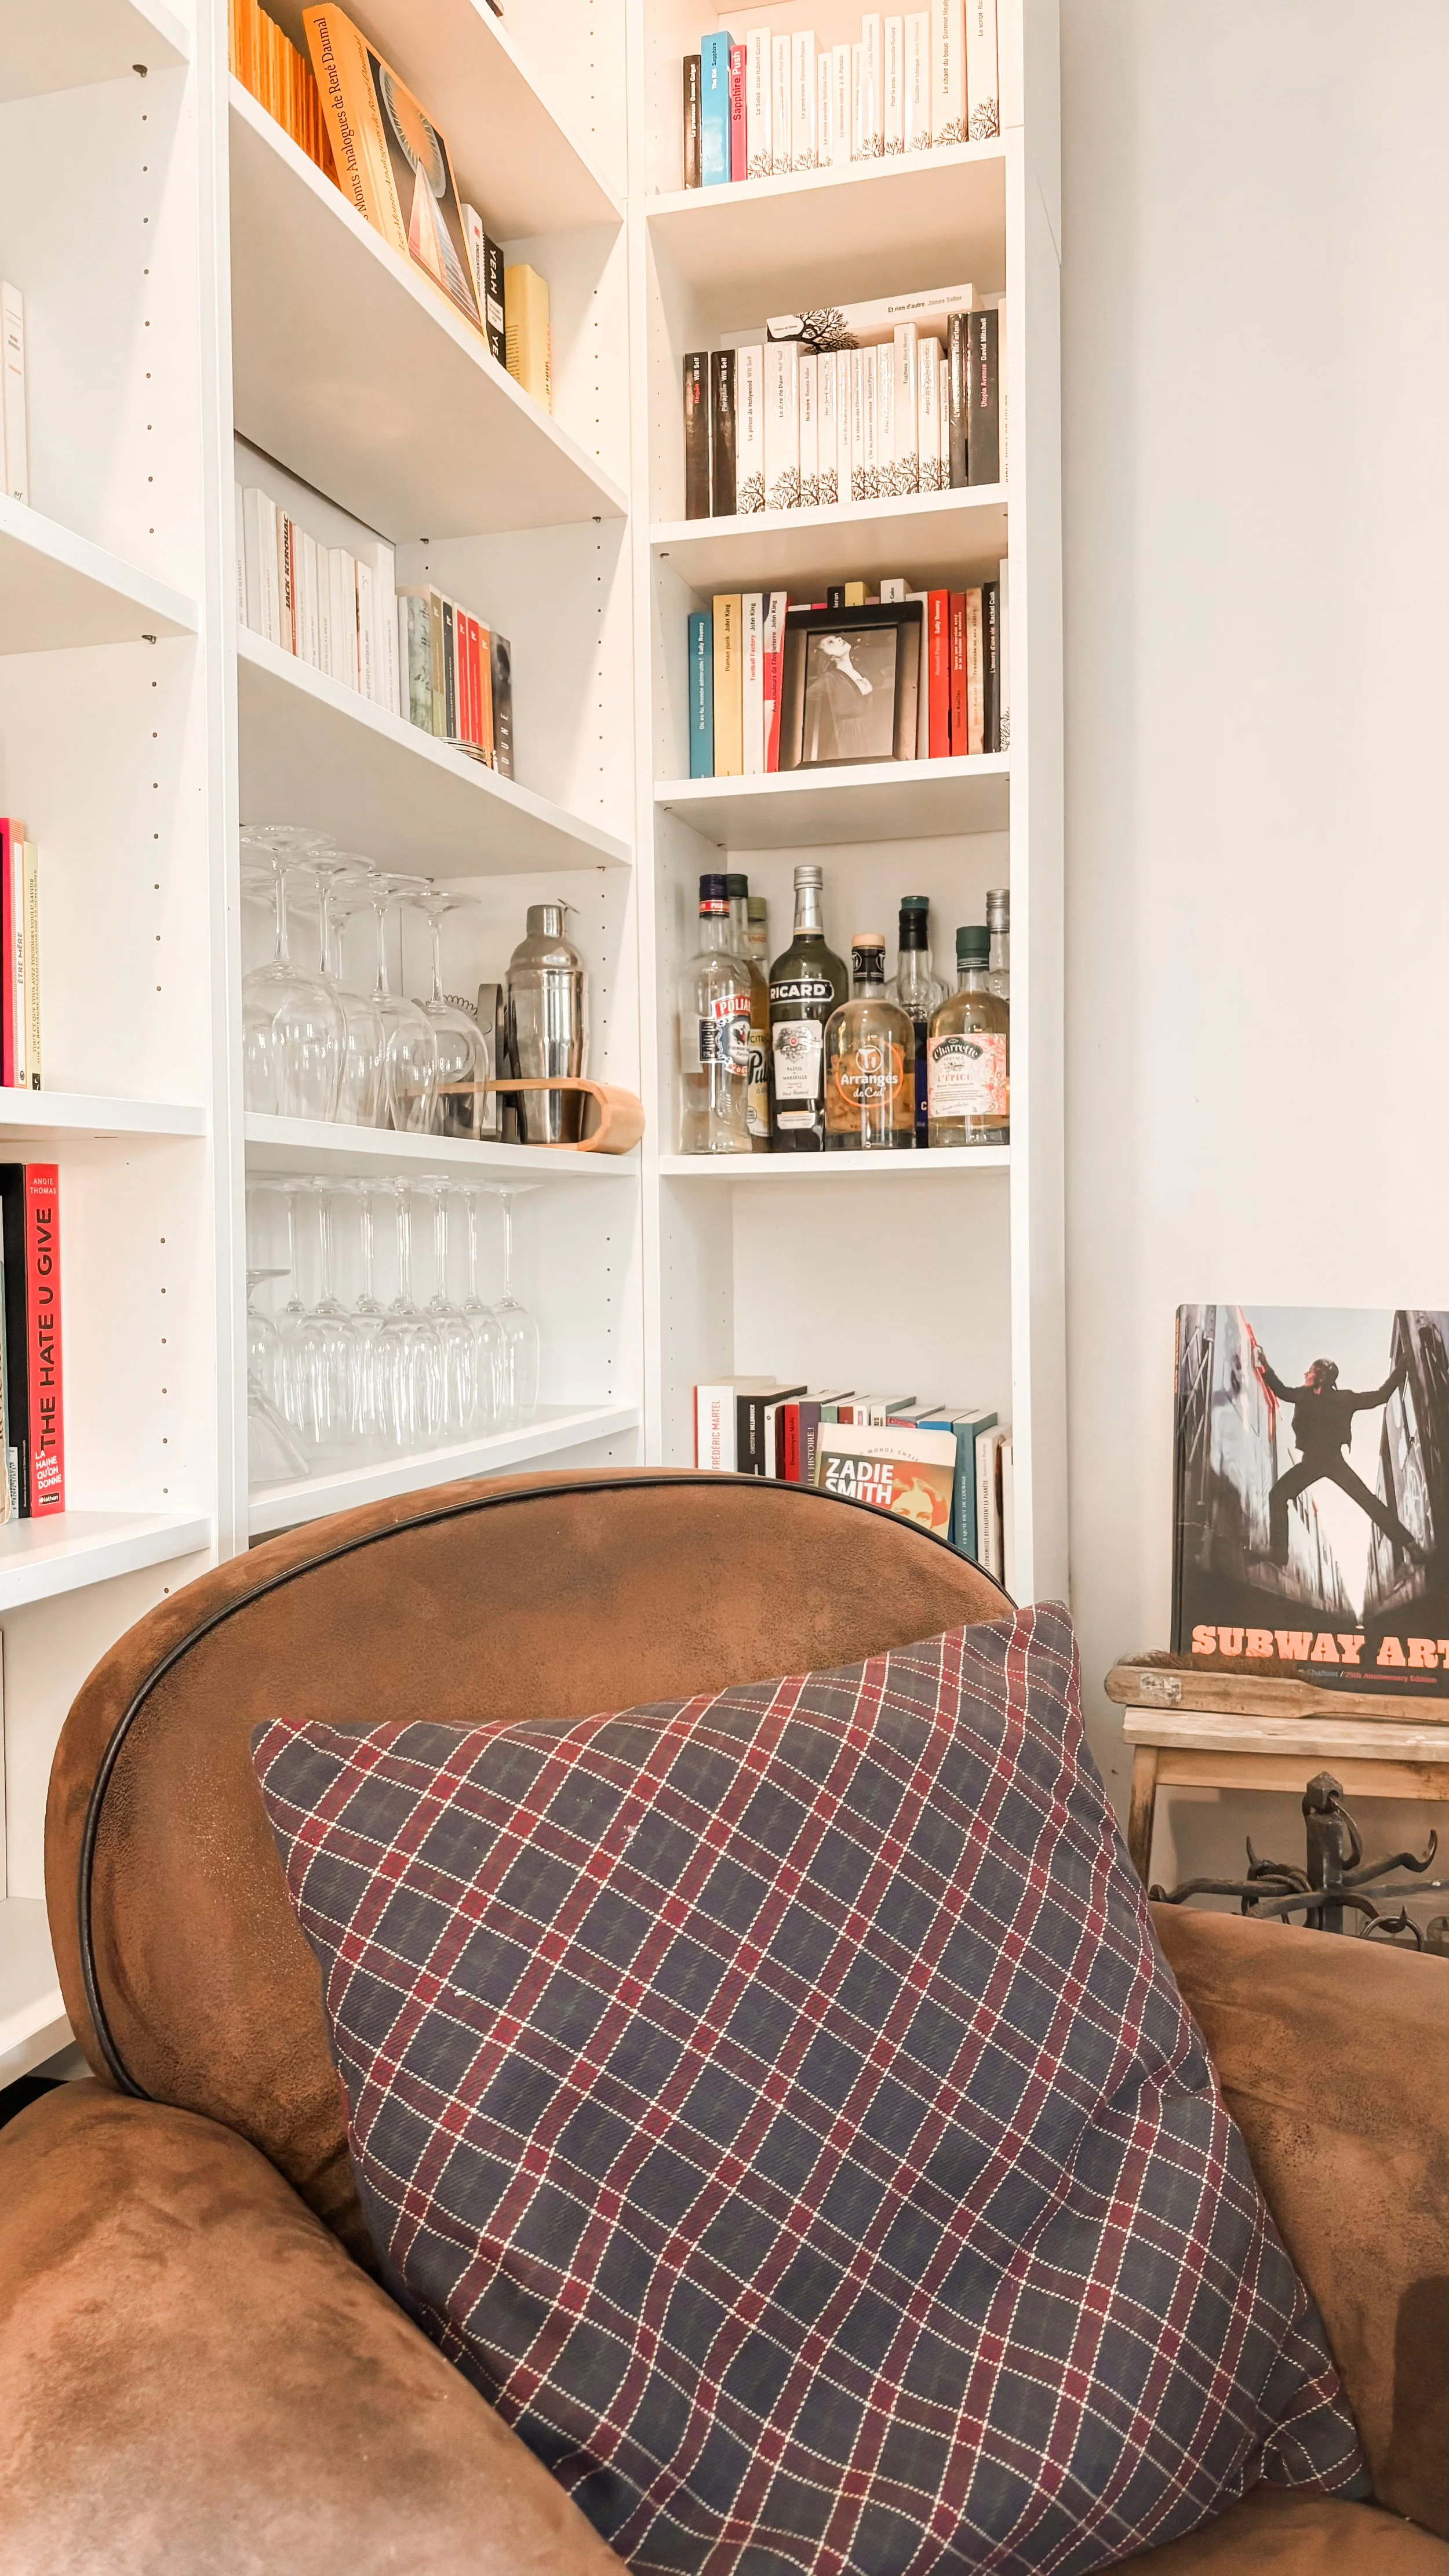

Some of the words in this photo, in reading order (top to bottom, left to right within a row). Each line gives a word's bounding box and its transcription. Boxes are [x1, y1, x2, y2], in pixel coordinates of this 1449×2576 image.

[313, 17, 335, 62] Daumal
[733, 51, 741, 76] Push
[324, 64, 341, 92] René
[331, 95, 344, 108] de
[733, 78, 742, 121] Sapphire
[337, 111, 358, 172] Analogues
[351, 174, 366, 213] Monts
[770, 984, 826, 1000] RICARD
[32, 1023, 37, 1032] CE
[934, 1044, 978, 1060] Charrette
[840, 1074, 898, 1087] Arrangés
[853, 1088, 864, 1098] de
[37, 1208, 52, 1275] GIVE
[38, 1286, 53, 1304] U
[38, 1314, 55, 1387] HATE
[40, 1396, 56, 1451] THE
[711, 1400, 720, 1430] MARTEL
[35, 1450, 46, 1460] LA
[36, 1456, 57, 1470] HAINE
[711, 1432, 720, 1469] FRÉDÉRIC
[37, 1465, 59, 1480] QU'ON
[38, 1474, 62, 1490] DONNE
[826, 1457, 894, 1485] ZADIE
[825, 1478, 893, 1504] SMITH
[1192, 1625, 1365, 1664] SUBWAY
[1410, 1675, 1437, 1683] Edition
